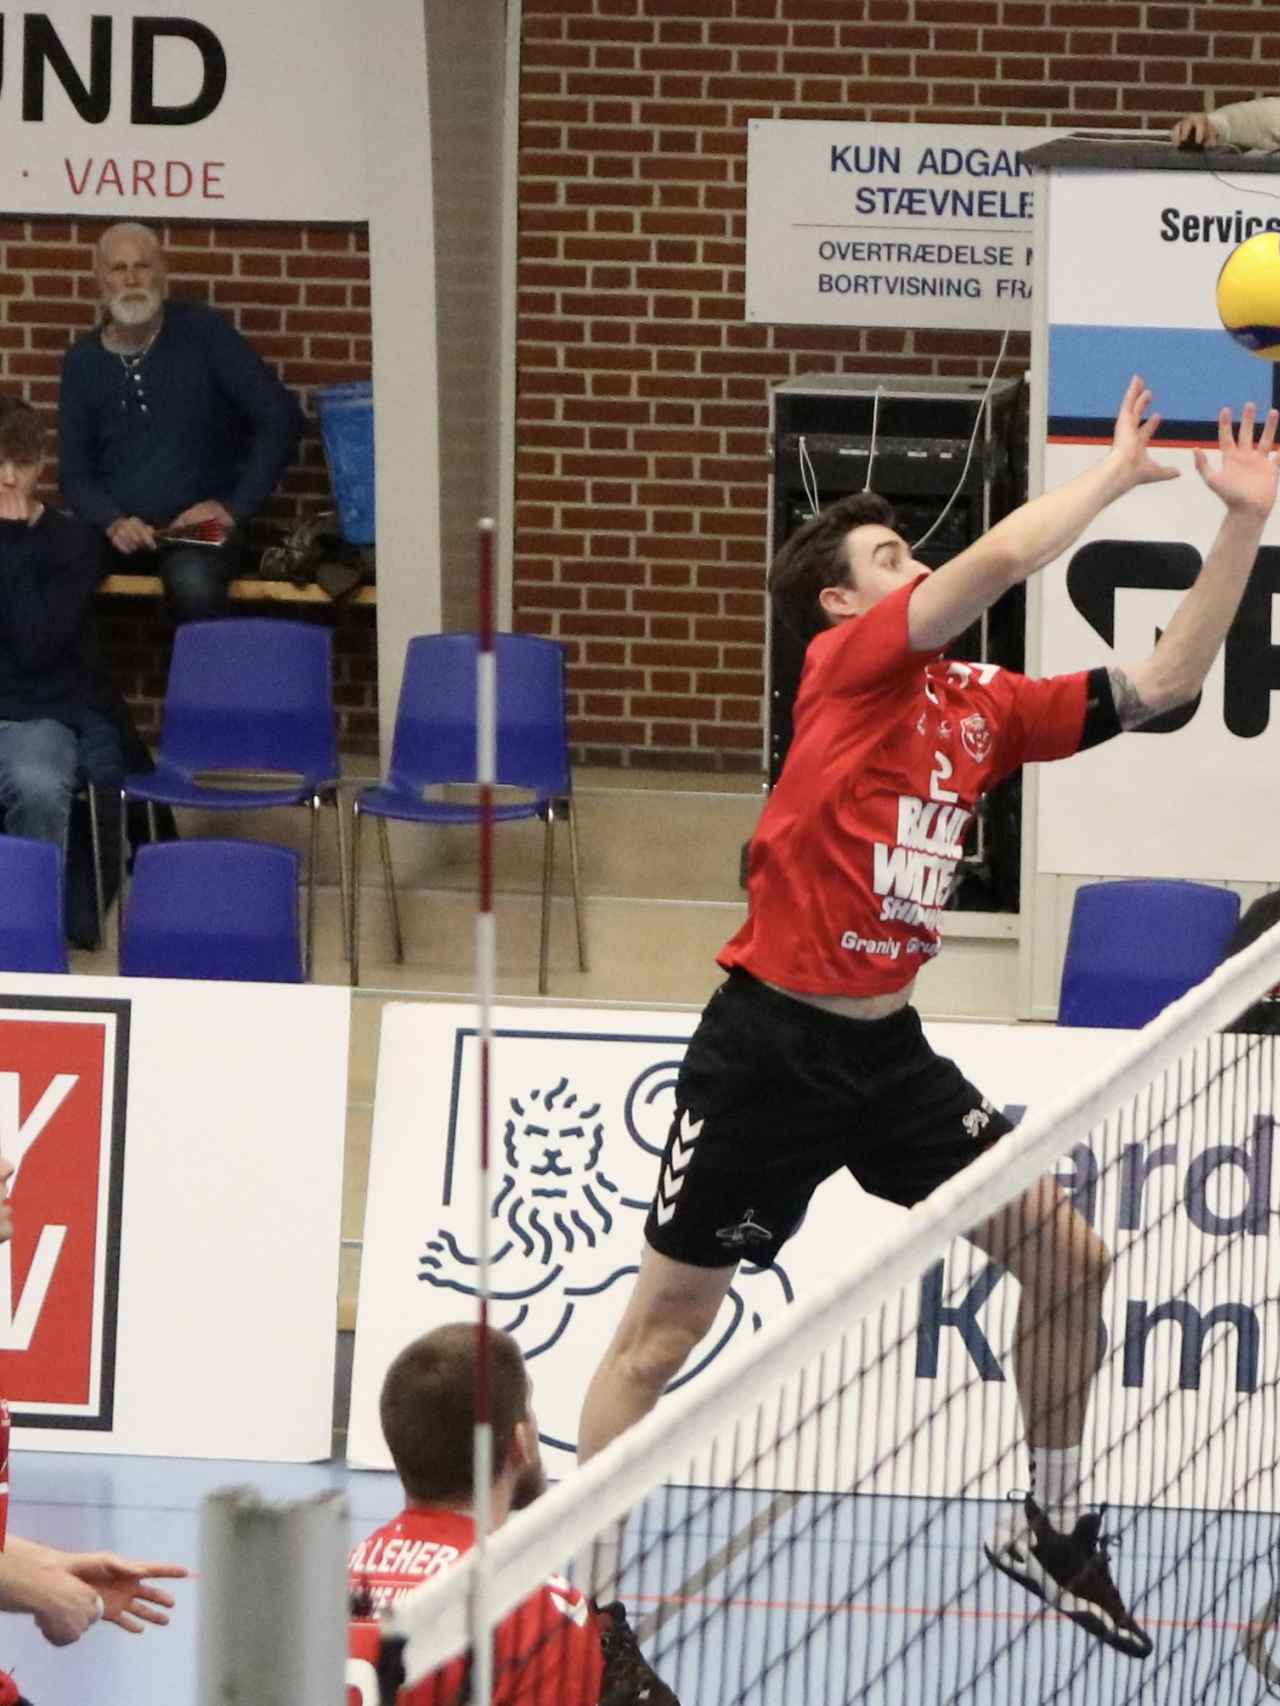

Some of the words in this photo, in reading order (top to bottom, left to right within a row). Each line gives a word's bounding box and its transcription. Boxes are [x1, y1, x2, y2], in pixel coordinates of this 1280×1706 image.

[0, 13, 228, 125] ND
[64, 158, 227, 199] VARDE
[830, 145, 901, 174] KUN
[818, 240, 1014, 267] OVERTRÆDELSE
[817, 274, 982, 299] BORTVISNING
[928, 750, 959, 803] 2
[349, 1537, 461, 1576] LLEHER
